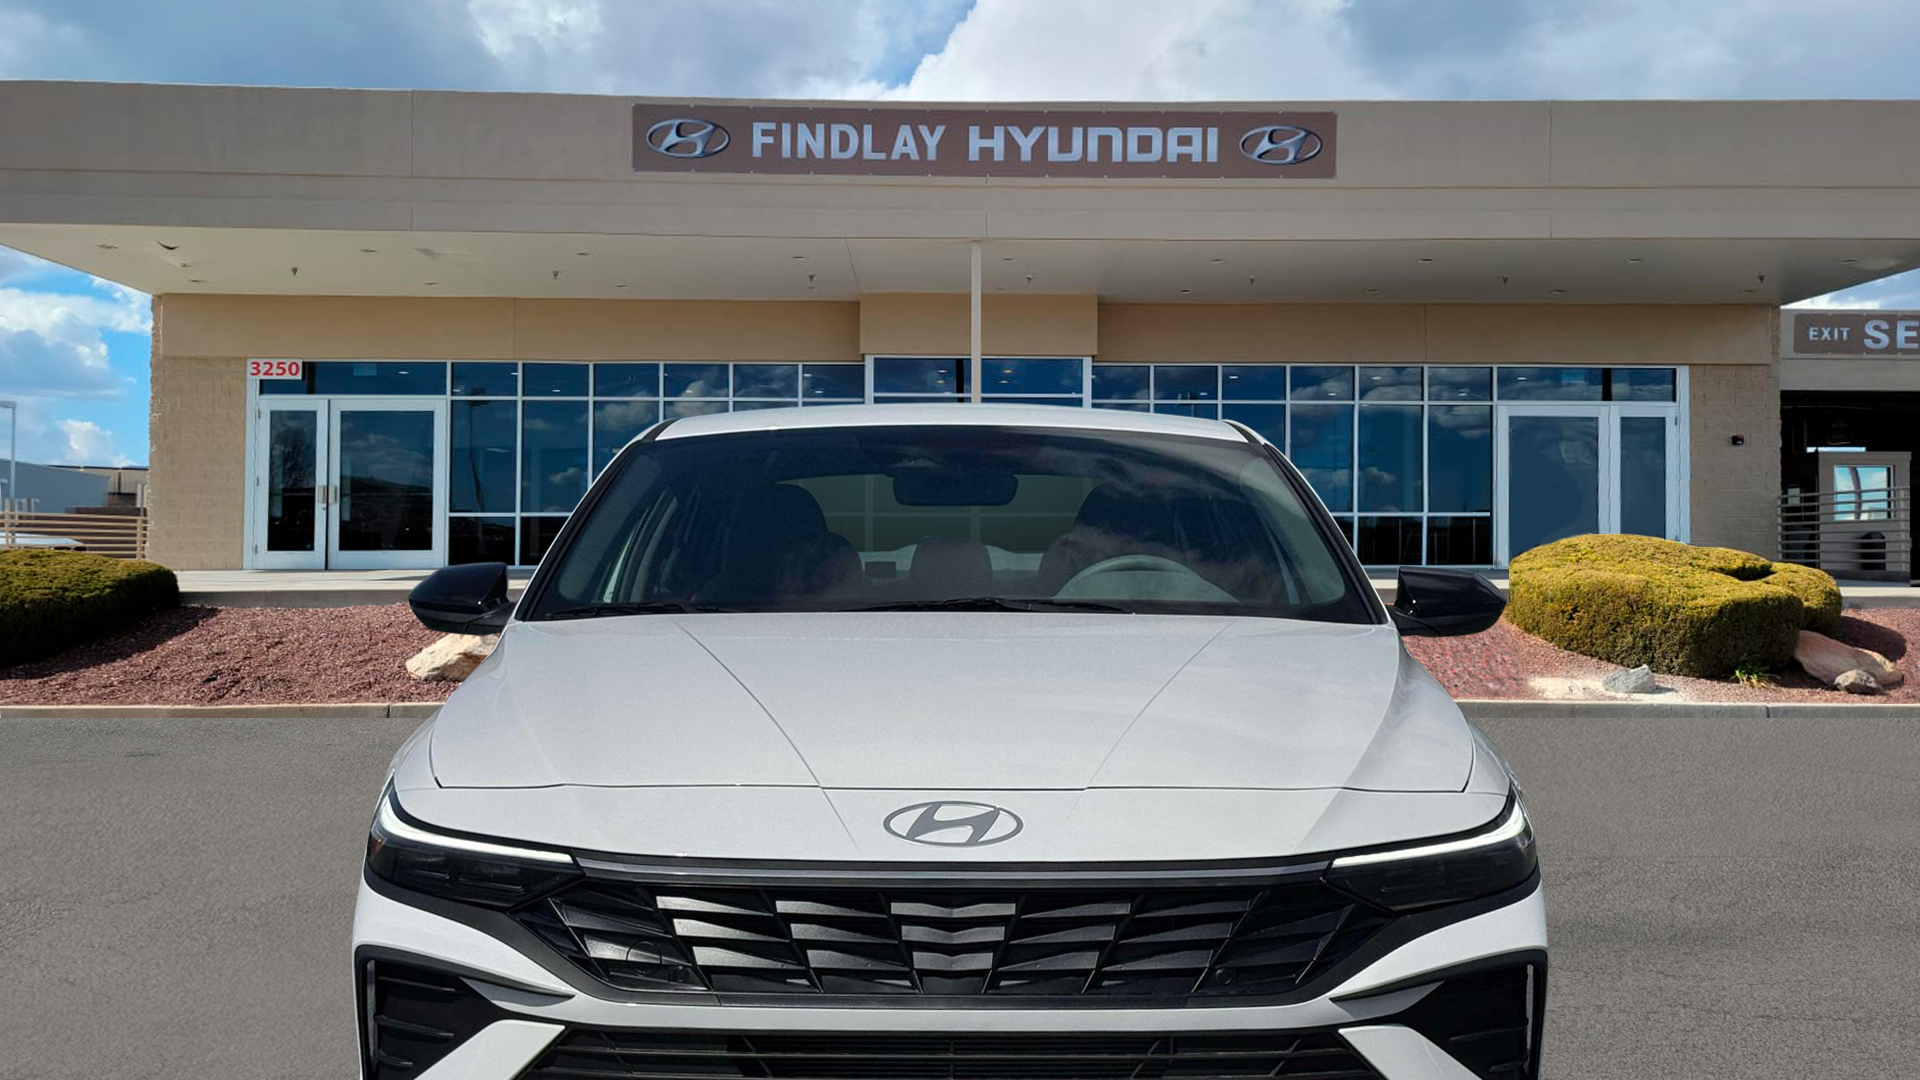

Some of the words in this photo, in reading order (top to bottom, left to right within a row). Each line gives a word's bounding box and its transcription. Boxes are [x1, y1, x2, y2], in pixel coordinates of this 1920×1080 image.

[752, 122, 946, 161] FINDLAY
[968, 125, 1219, 163] HYUNDAI
[1809, 327, 1850, 341] EXIT
[1863, 320, 1920, 350] SE
[249, 361, 300, 376] 3250
